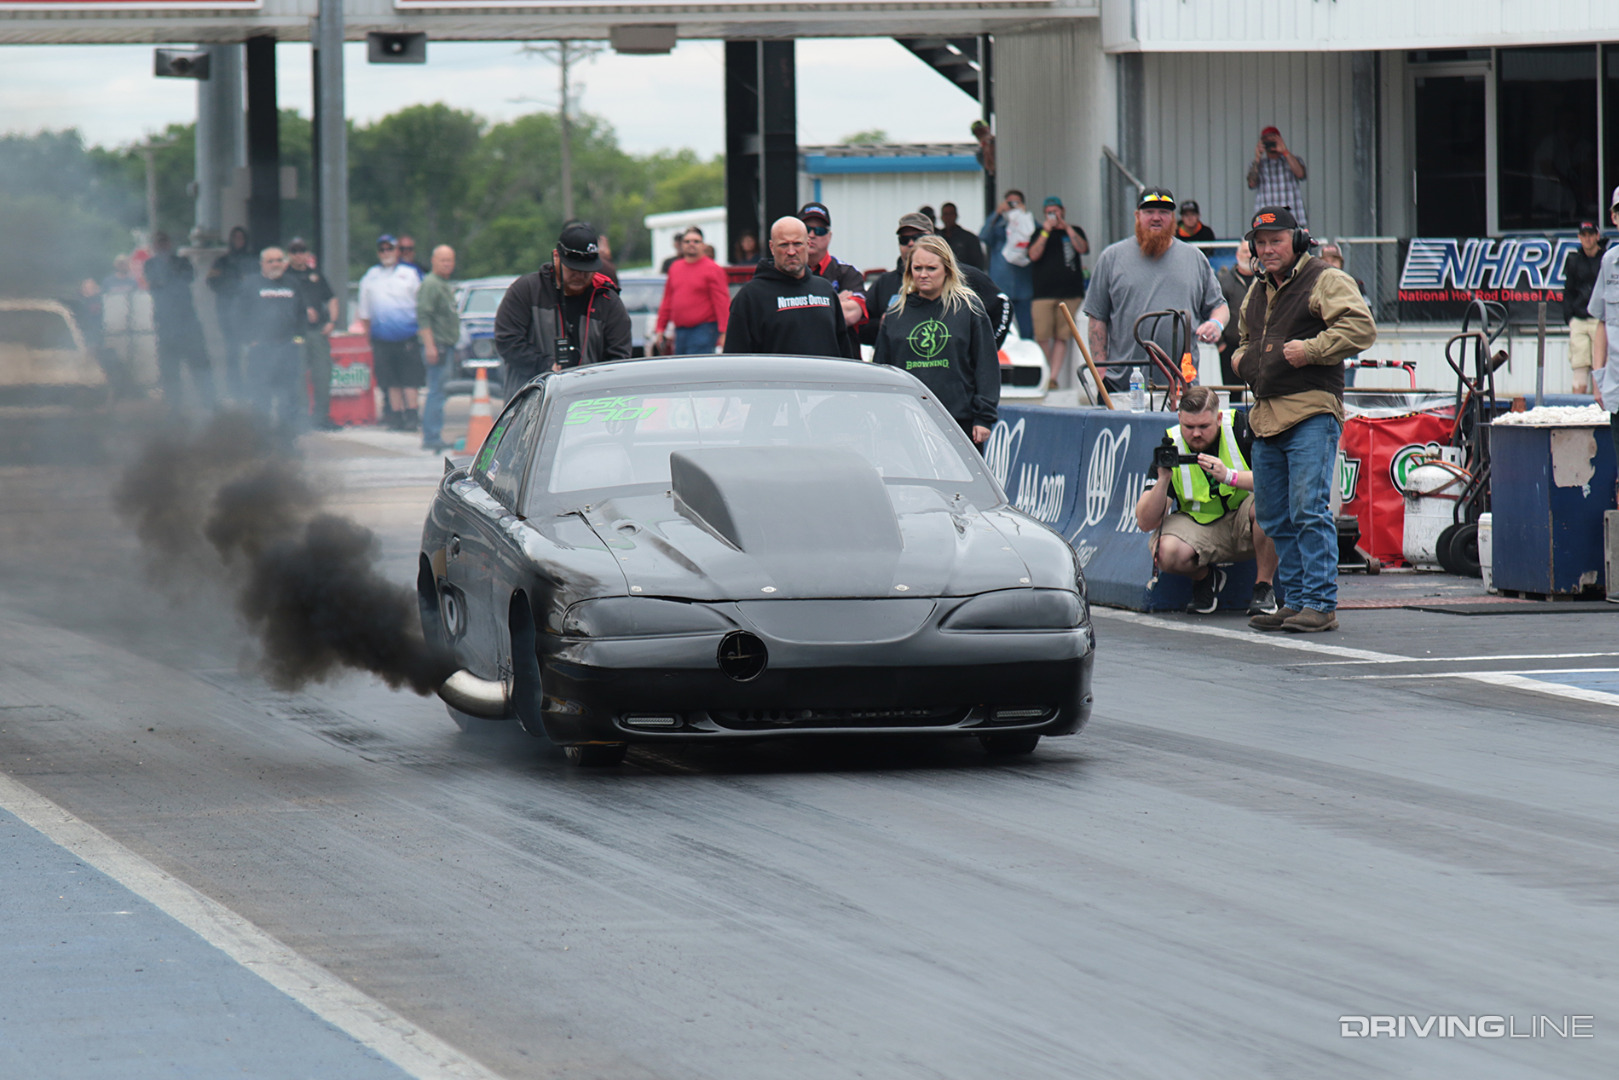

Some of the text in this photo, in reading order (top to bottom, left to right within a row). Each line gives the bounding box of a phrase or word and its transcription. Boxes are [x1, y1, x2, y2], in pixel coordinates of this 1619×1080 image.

[1398, 290, 1449, 301] National
[1451, 290, 1472, 301] Hot
[1475, 290, 1499, 301] Rod
[1501, 290, 1542, 301] Diesel
[906, 359, 949, 370] BROWNING
[566, 396, 638, 413] PSK
[563, 406, 659, 425] 5701
